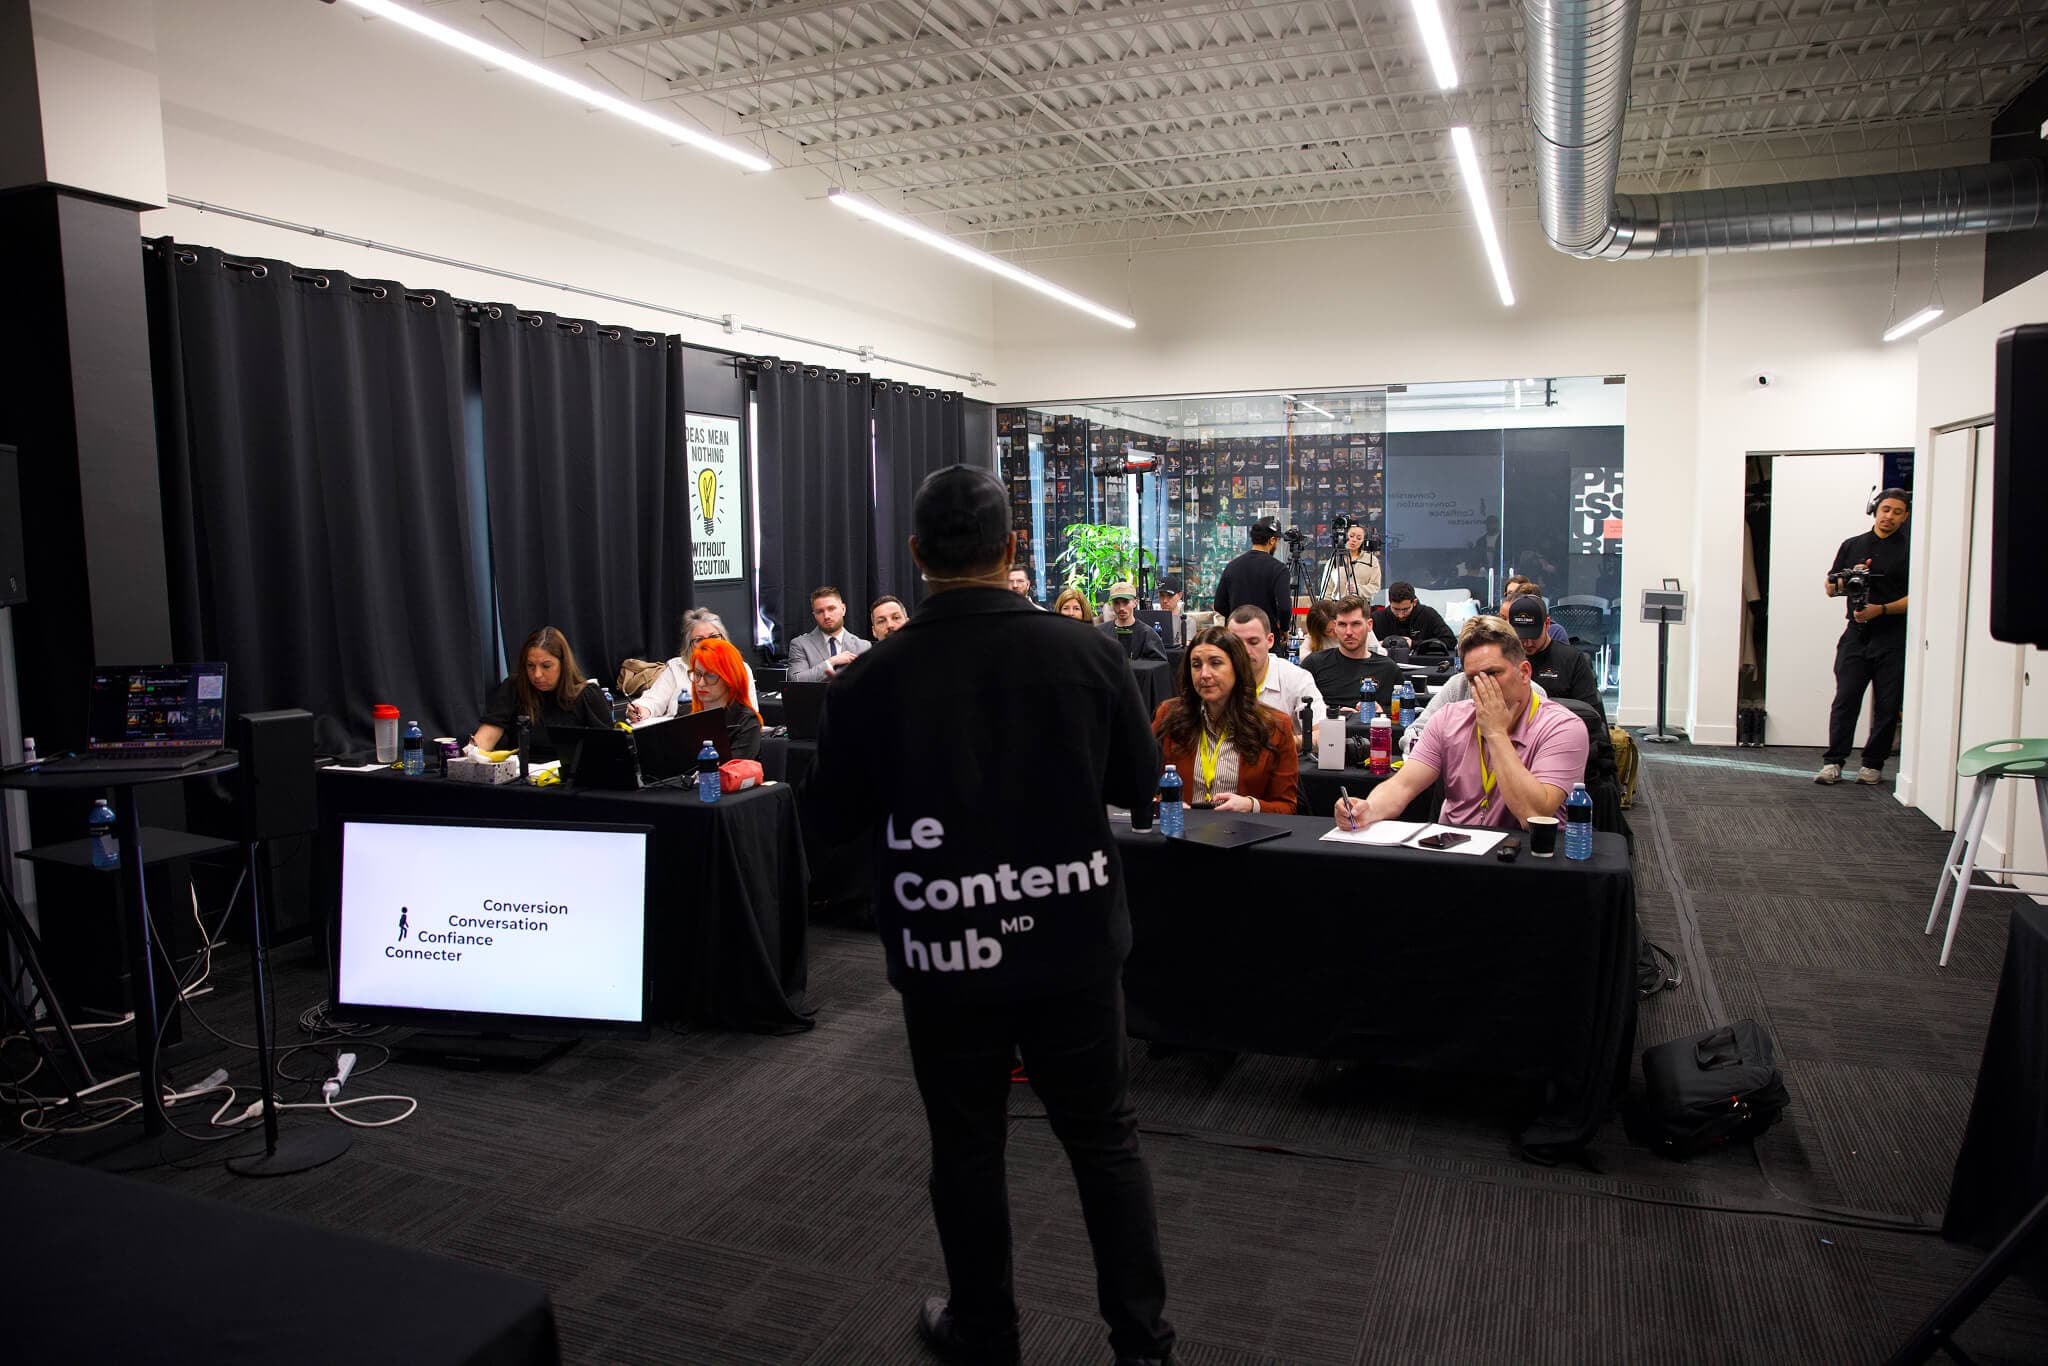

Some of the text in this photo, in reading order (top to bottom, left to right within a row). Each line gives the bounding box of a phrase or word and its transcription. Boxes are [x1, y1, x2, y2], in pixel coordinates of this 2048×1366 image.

[685, 427, 729, 445] DEAS MEAN
[691, 446, 724, 463] NOTHING
[691, 541, 726, 557] WITHOUT
[693, 559, 730, 576] XECUTION
[886, 812, 945, 851] Le
[893, 849, 1110, 912] Content
[483, 899, 569, 915] Conversion
[448, 914, 549, 932] Conversation
[418, 930, 494, 946] Confiance
[902, 915, 1035, 972] hub MD
[385, 946, 462, 962] Connecter
